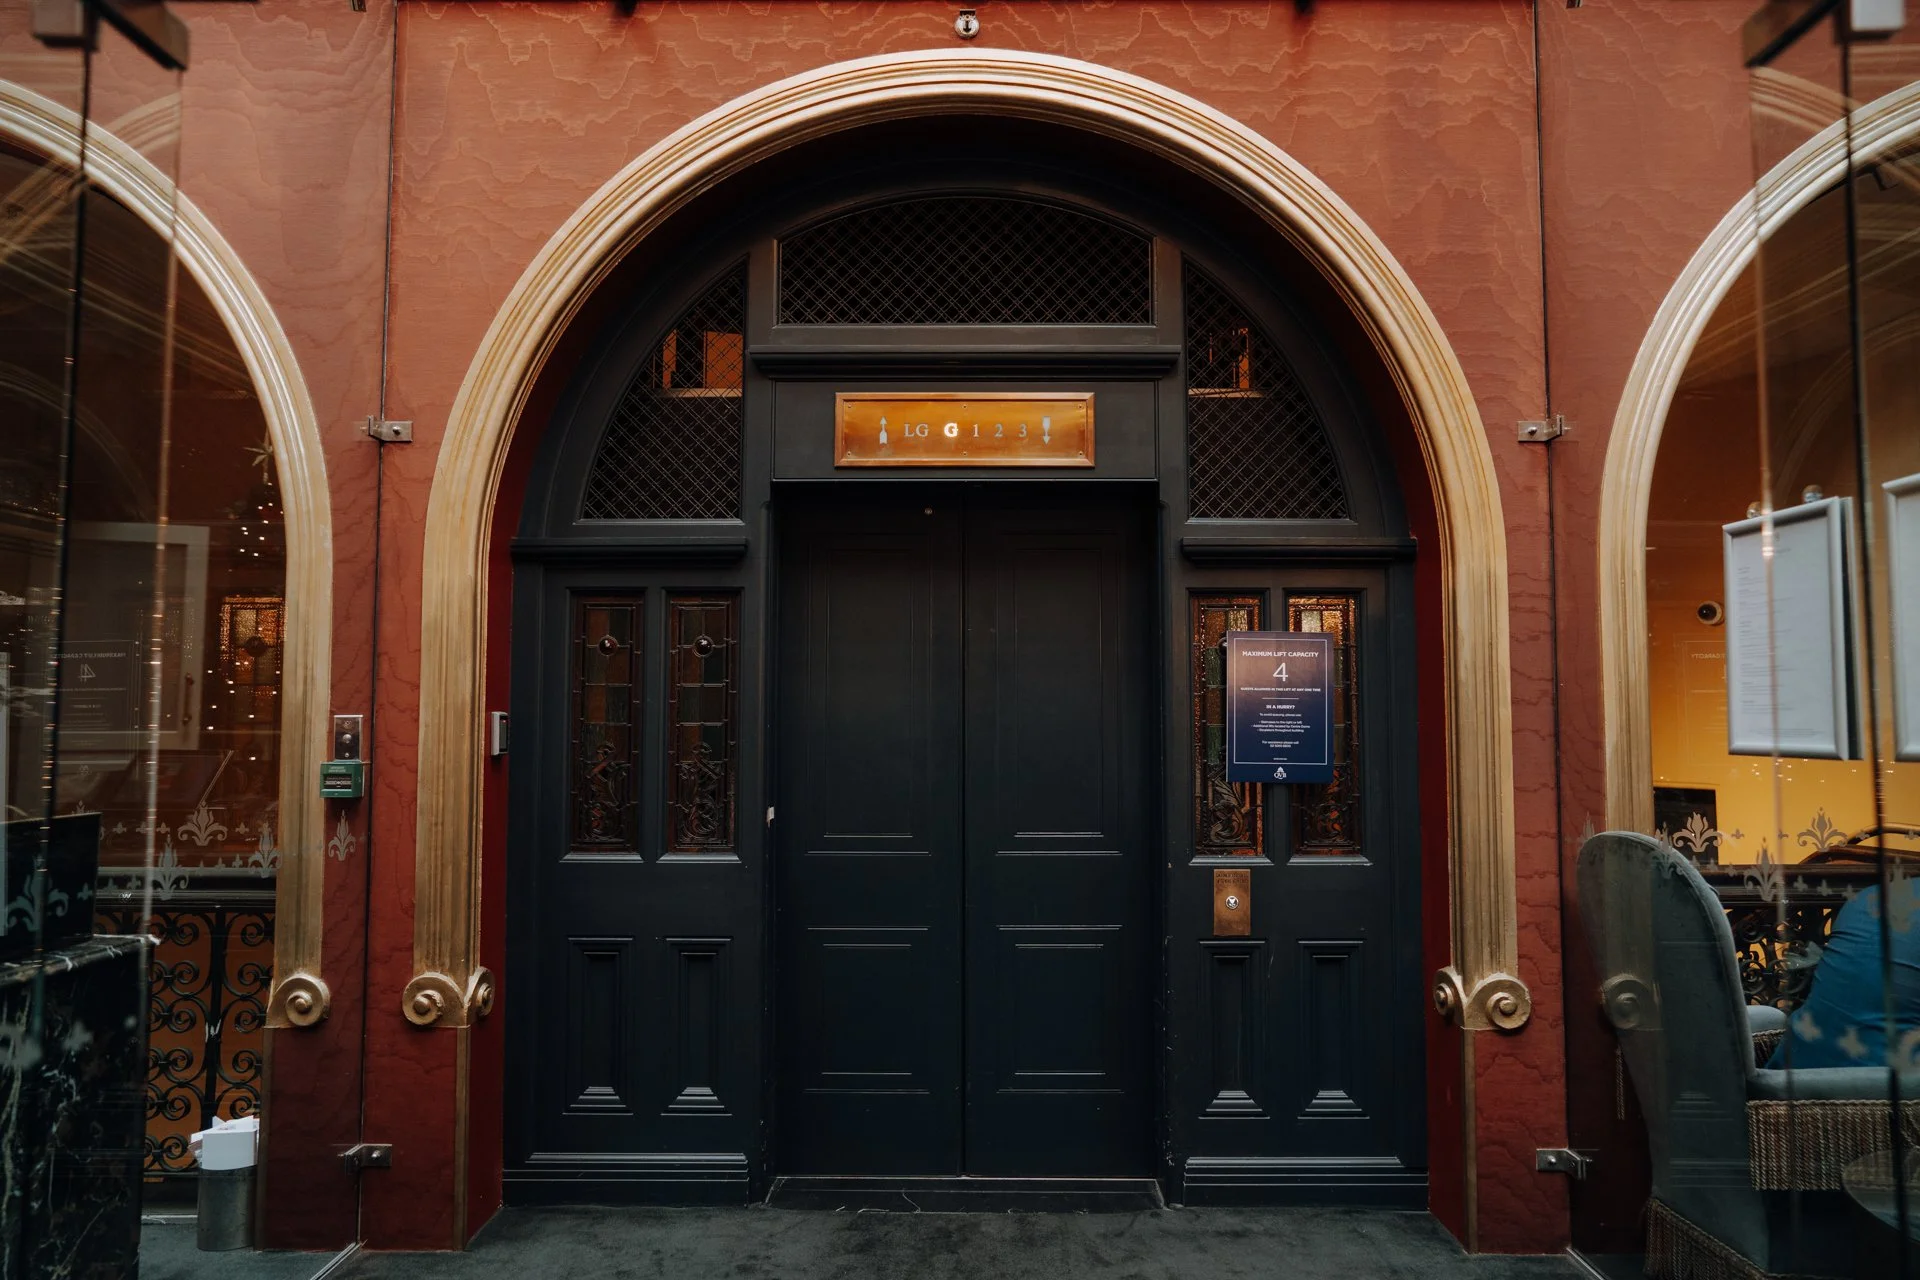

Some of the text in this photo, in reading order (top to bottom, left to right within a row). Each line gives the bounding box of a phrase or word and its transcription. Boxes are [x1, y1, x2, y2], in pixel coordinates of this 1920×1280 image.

[904, 422, 1028, 438] LG G 1 2 3
[1273, 662, 1288, 682] 4
